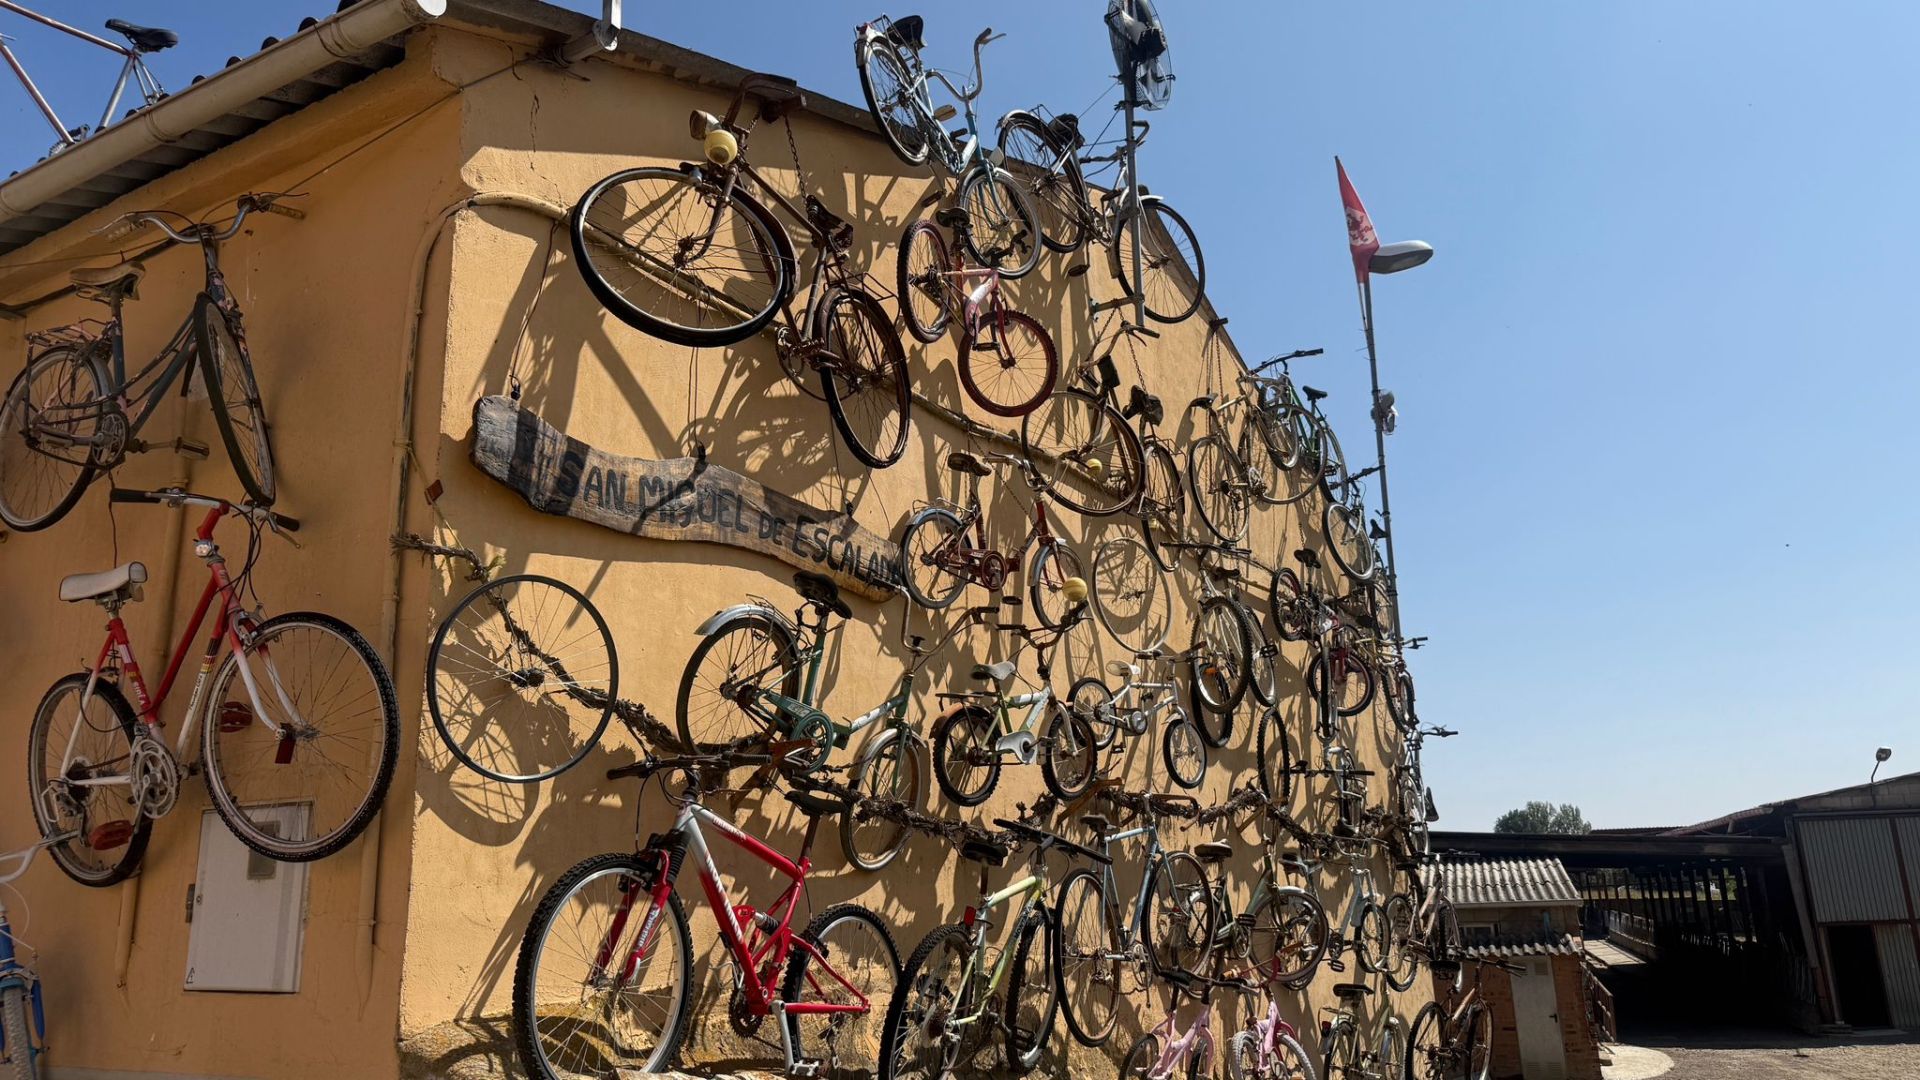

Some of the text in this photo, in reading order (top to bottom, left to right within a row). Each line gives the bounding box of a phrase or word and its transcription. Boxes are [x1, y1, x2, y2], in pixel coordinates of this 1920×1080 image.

[558, 452, 628, 512] SAN
[639, 475, 749, 533] MIGUEL
[759, 511, 787, 545] DE
